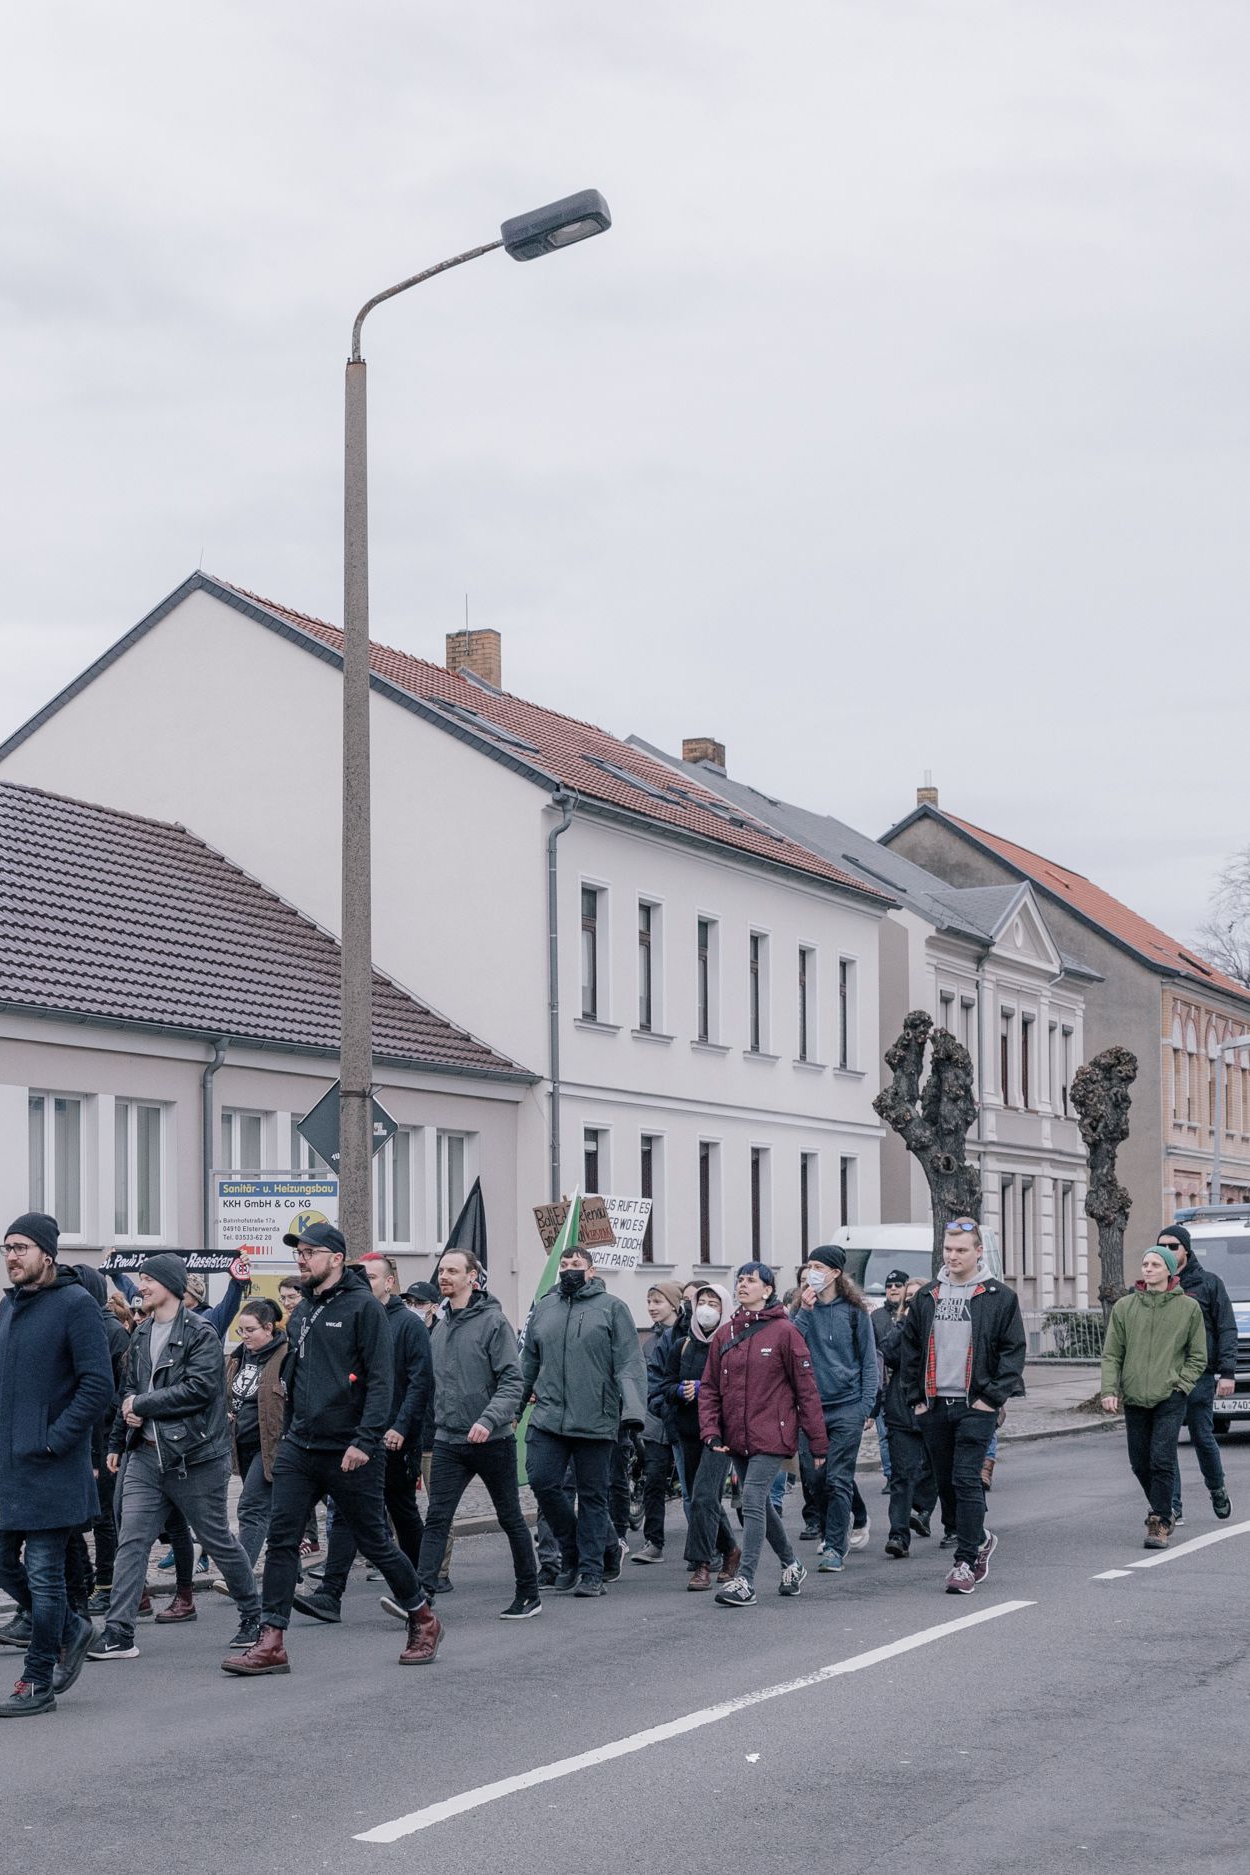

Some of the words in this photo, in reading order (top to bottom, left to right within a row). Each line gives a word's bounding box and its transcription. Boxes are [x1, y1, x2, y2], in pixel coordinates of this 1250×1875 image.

[223, 1184, 260, 1193] Sanitär-
[274, 1184, 334, 1195] Heizungsbau
[223, 1200, 241, 1208] KKH
[244, 1200, 271, 1208] GmbH
[274, 1200, 281, 1208] &
[284, 1200, 295, 1208] Co
[298, 1200, 311, 1208] KG
[617, 1200, 638, 1213] RUFT
[639, 1201, 651, 1215] ES
[632, 1219, 645, 1232] ES
[621, 1237, 642, 1250] DOCH
[114, 1253, 138, 1268] Pauli
[186, 1252, 234, 1268] Rassisten
